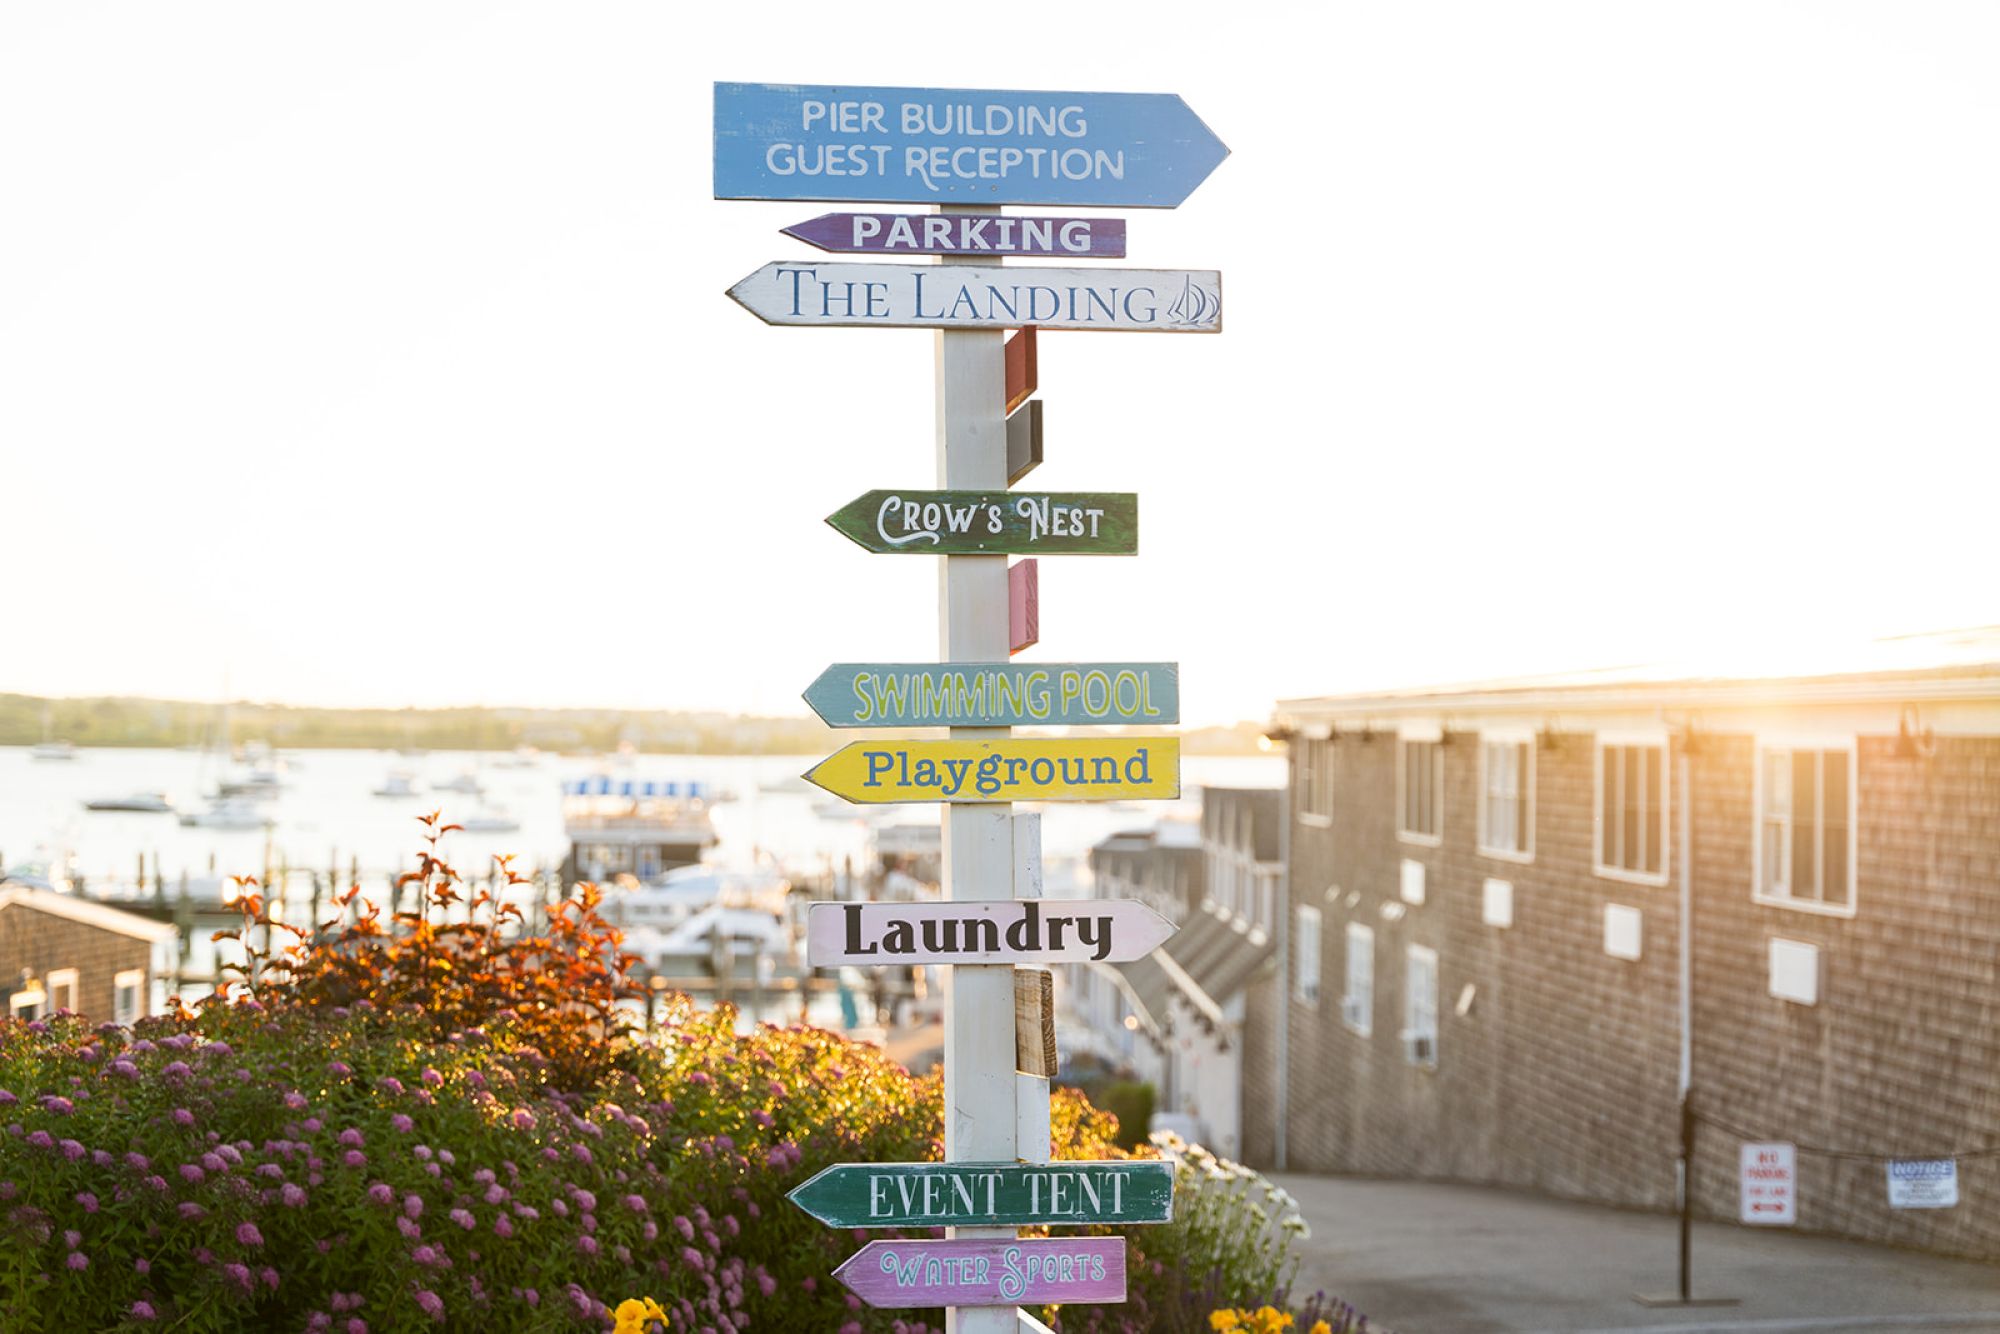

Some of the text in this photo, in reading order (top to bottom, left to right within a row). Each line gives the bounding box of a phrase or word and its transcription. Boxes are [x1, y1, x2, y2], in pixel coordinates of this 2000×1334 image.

[802, 100, 1088, 138] PIER BUILDING
[766, 143, 1124, 191] GUEST RECEPTION
[852, 216, 1092, 252] PARKING
[776, 268, 1157, 324] THE LANDING
[876, 495, 1105, 545] CROW'S NEST
[853, 669, 1160, 721] SWIMMING POOL
[862, 748, 1153, 795] Playground
[843, 902, 1114, 962] Laundry
[1893, 1160, 1952, 1175] NOTICE
[868, 1172, 1131, 1218] EVENT TENT
[879, 1246, 1107, 1300] WATER SPORTS
